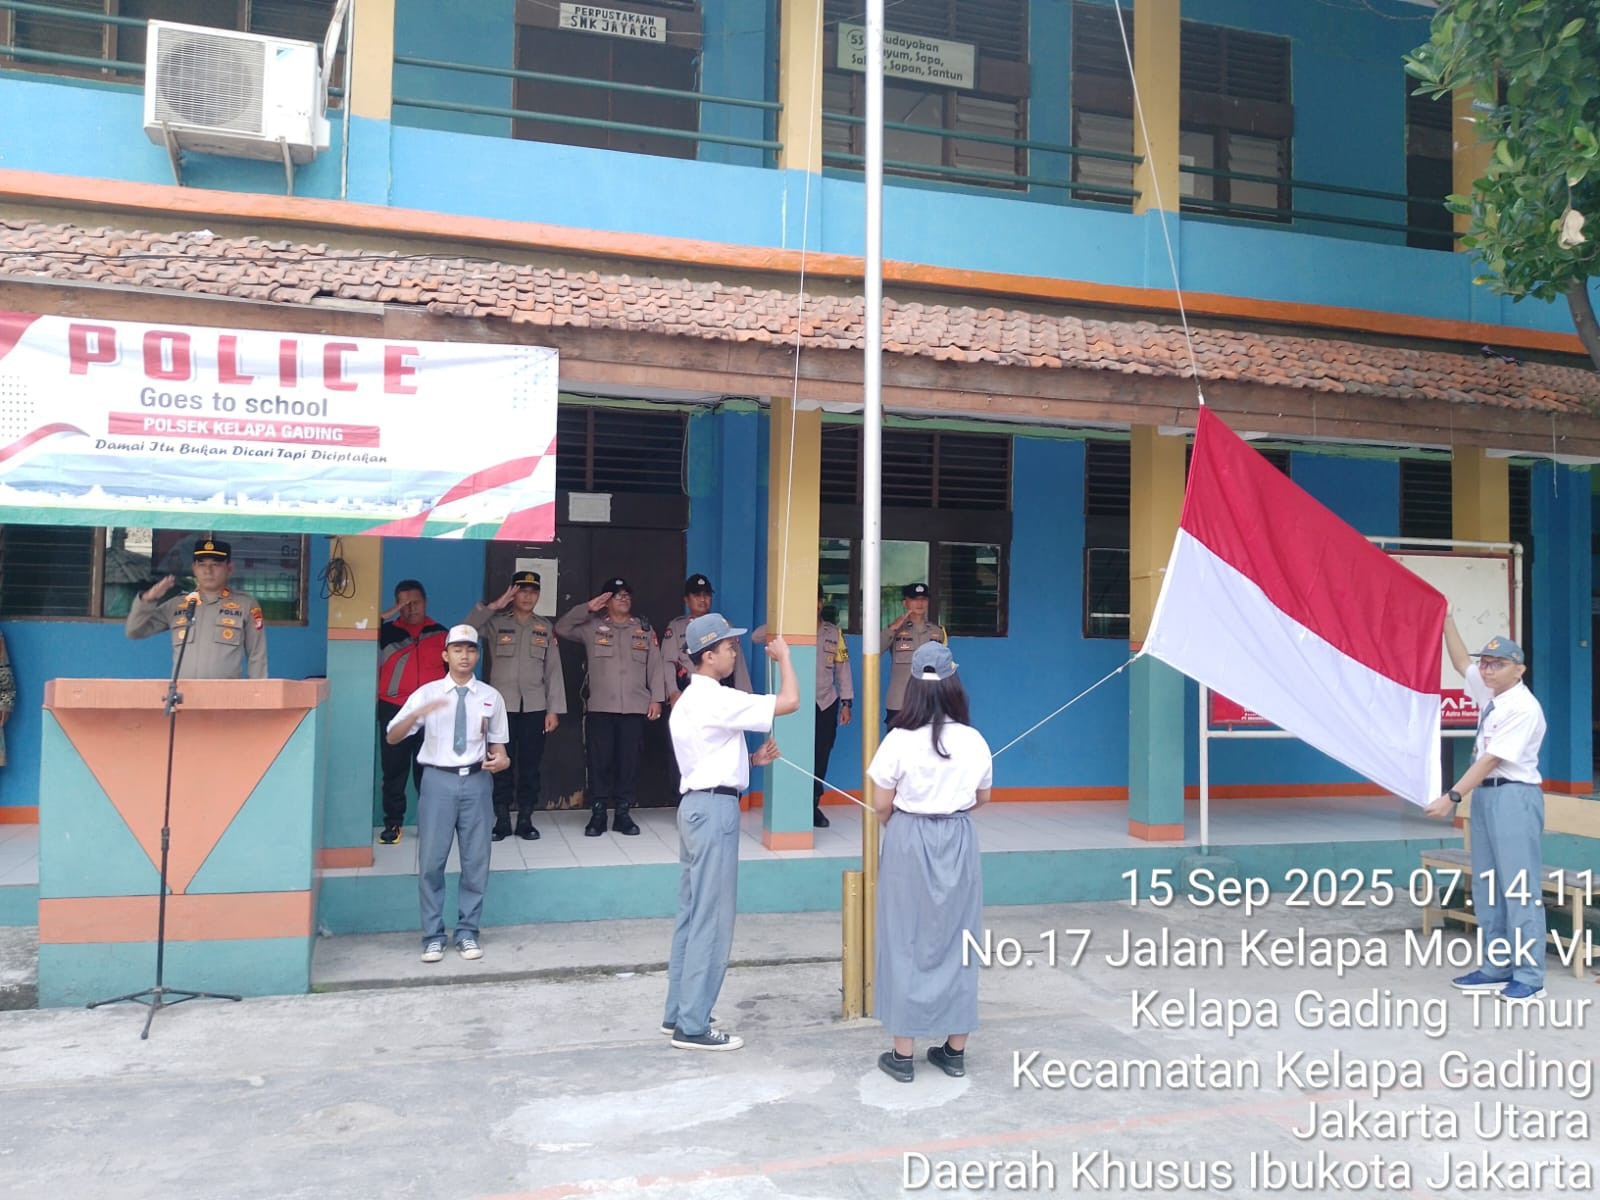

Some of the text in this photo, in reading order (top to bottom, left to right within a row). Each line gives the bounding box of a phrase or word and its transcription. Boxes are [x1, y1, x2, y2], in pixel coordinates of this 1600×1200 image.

[574, 6, 655, 26] PERPUSTAKAAN
[884, 35, 939, 53] udayakan
[916, 52, 945, 67] Sapa,
[927, 66, 963, 81] Santun
[68, 323, 419, 395] POLICE
[140, 386, 328, 417] Goes to school
[143, 417, 344, 441] POLSEK KELAPA GADING
[95, 438, 388, 464] Damai Itu Bukan Dicari Tapi Diciptakan
[219, 608, 242, 617] POLRI
